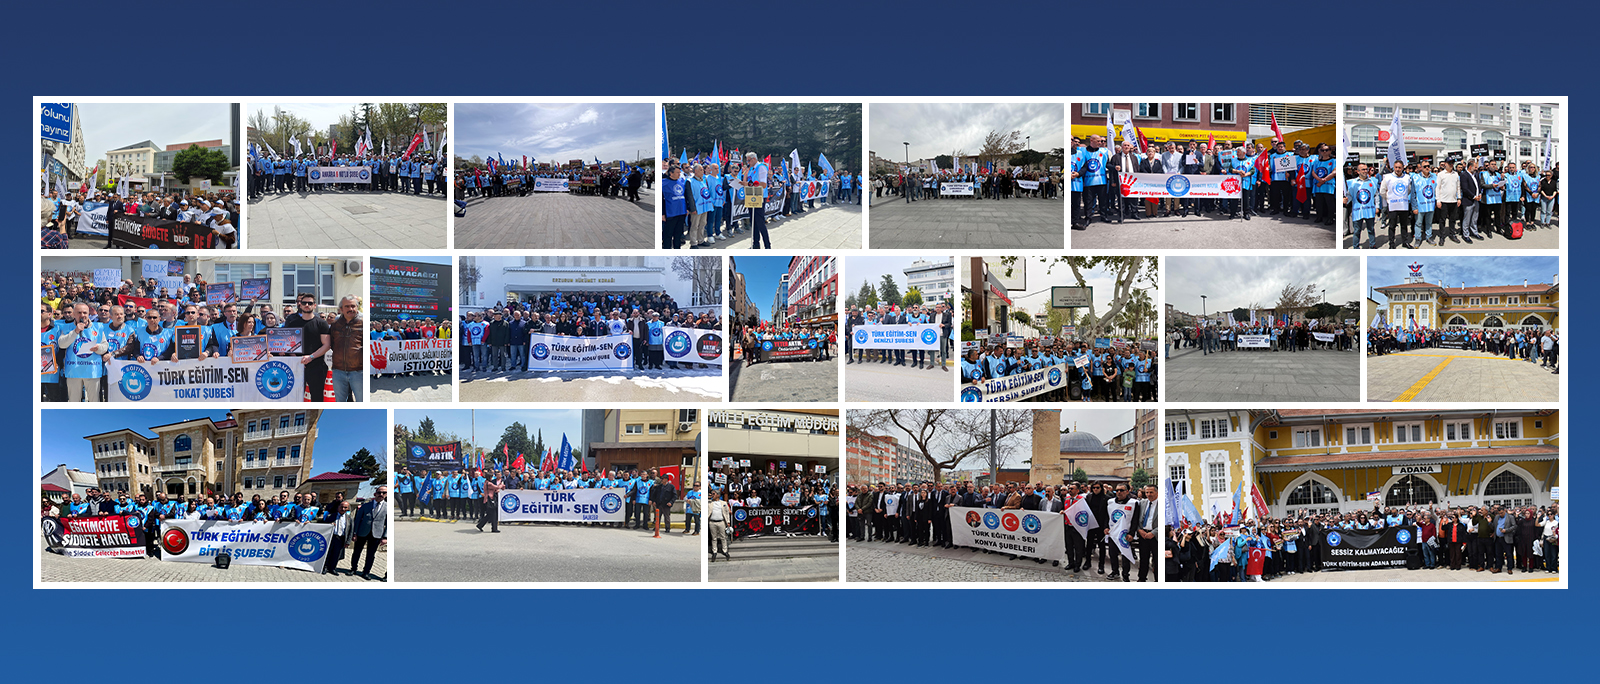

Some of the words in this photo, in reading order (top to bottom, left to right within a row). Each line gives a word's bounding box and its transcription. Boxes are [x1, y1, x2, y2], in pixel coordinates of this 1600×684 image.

[142, 223, 169, 242] ŞİDDETE
[174, 234, 190, 244] DUR
[886, 330, 918, 338] EĞİTİM-SEN
[404, 341, 430, 350] ARTIK
[551, 343, 570, 352] TÜRK
[572, 342, 613, 353] EĞİTİM-SEN
[158, 371, 185, 385] TÜRK
[187, 367, 249, 385] EĞİTİM-SEN
[985, 380, 1007, 395] TÜRK
[1021, 383, 1046, 397] ŞUBESİ
[173, 388, 200, 399] TOKAT
[203, 387, 235, 401] ŞUBESİ
[709, 410, 744, 425] MİLLİ
[748, 412, 791, 428] EĞİTİM
[429, 451, 453, 460] ARTIK
[1399, 466, 1434, 474] ADANA
[544, 491, 576, 502] TÜRK
[522, 502, 563, 513] EĞİTİM
[573, 504, 599, 514] SEN
[749, 508, 781, 516] EĞİTİMCİYE
[68, 518, 120, 533] EĞİTİMCİYE
[190, 530, 218, 542] TÜRK
[221, 529, 289, 544] EĞİTİM-SEN
[972, 530, 990, 538] TÜRK
[991, 531, 1016, 541] EĞİTİM
[974, 539, 998, 548] KONYA
[999, 542, 1036, 553] ŞUBELERİ
[1331, 548, 1353, 556] SESSİZ
[1355, 546, 1405, 556] KALMAYACAĞIZ
[234, 546, 276, 559] ŞUBESİ
